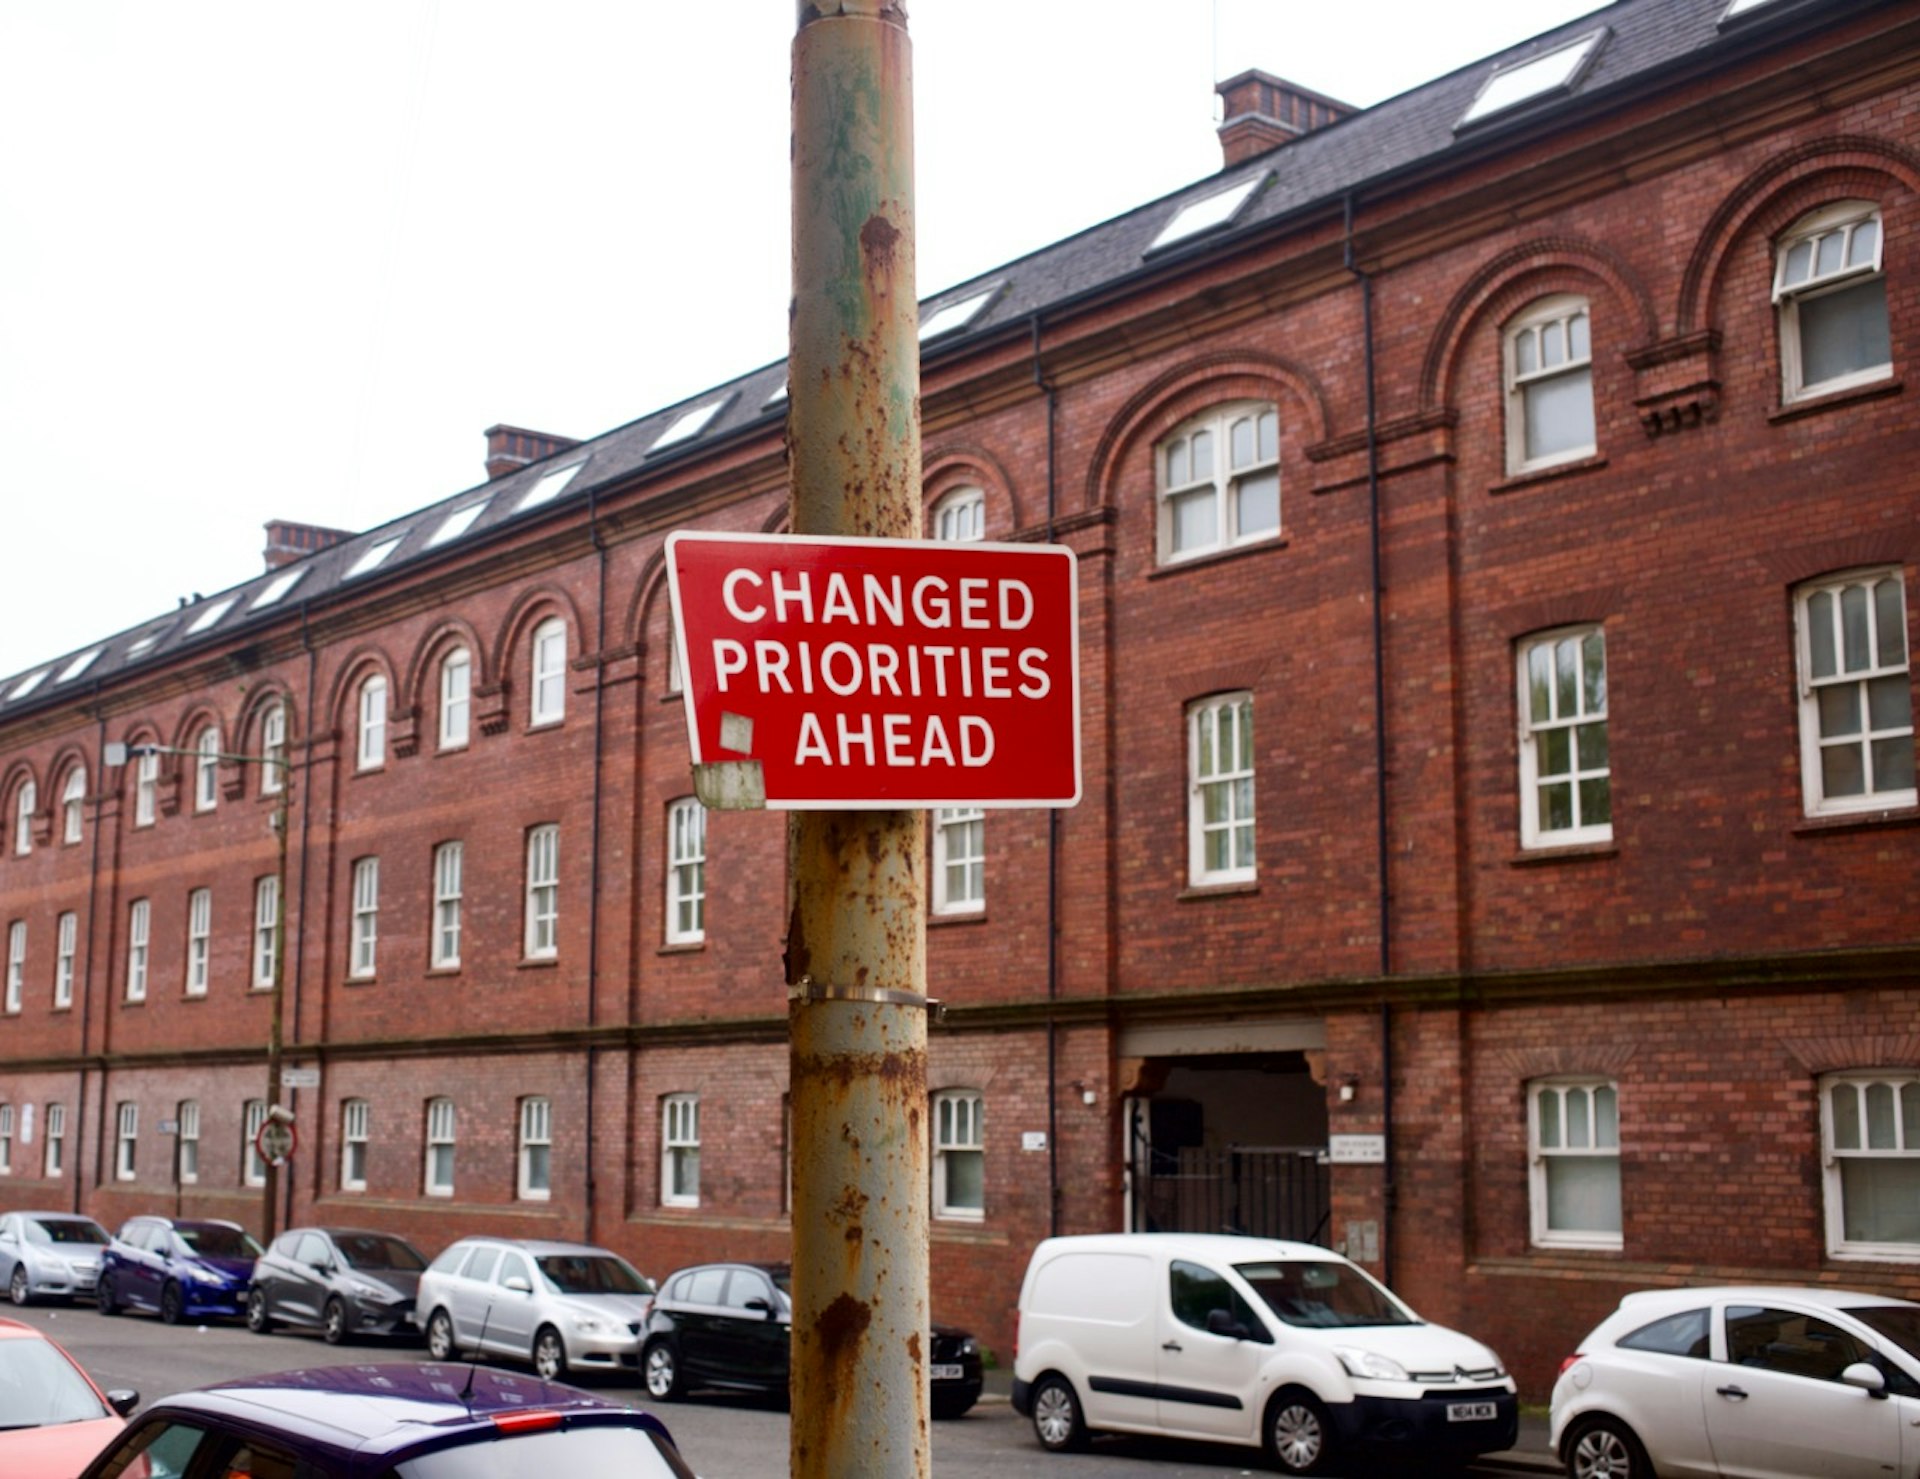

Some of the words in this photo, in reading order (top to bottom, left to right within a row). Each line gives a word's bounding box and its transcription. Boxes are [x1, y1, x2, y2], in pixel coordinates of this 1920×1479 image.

[722, 568, 1034, 630] CHANGED
[712, 639, 1051, 699] PRIORITIES
[795, 713, 995, 767] AHEAD
